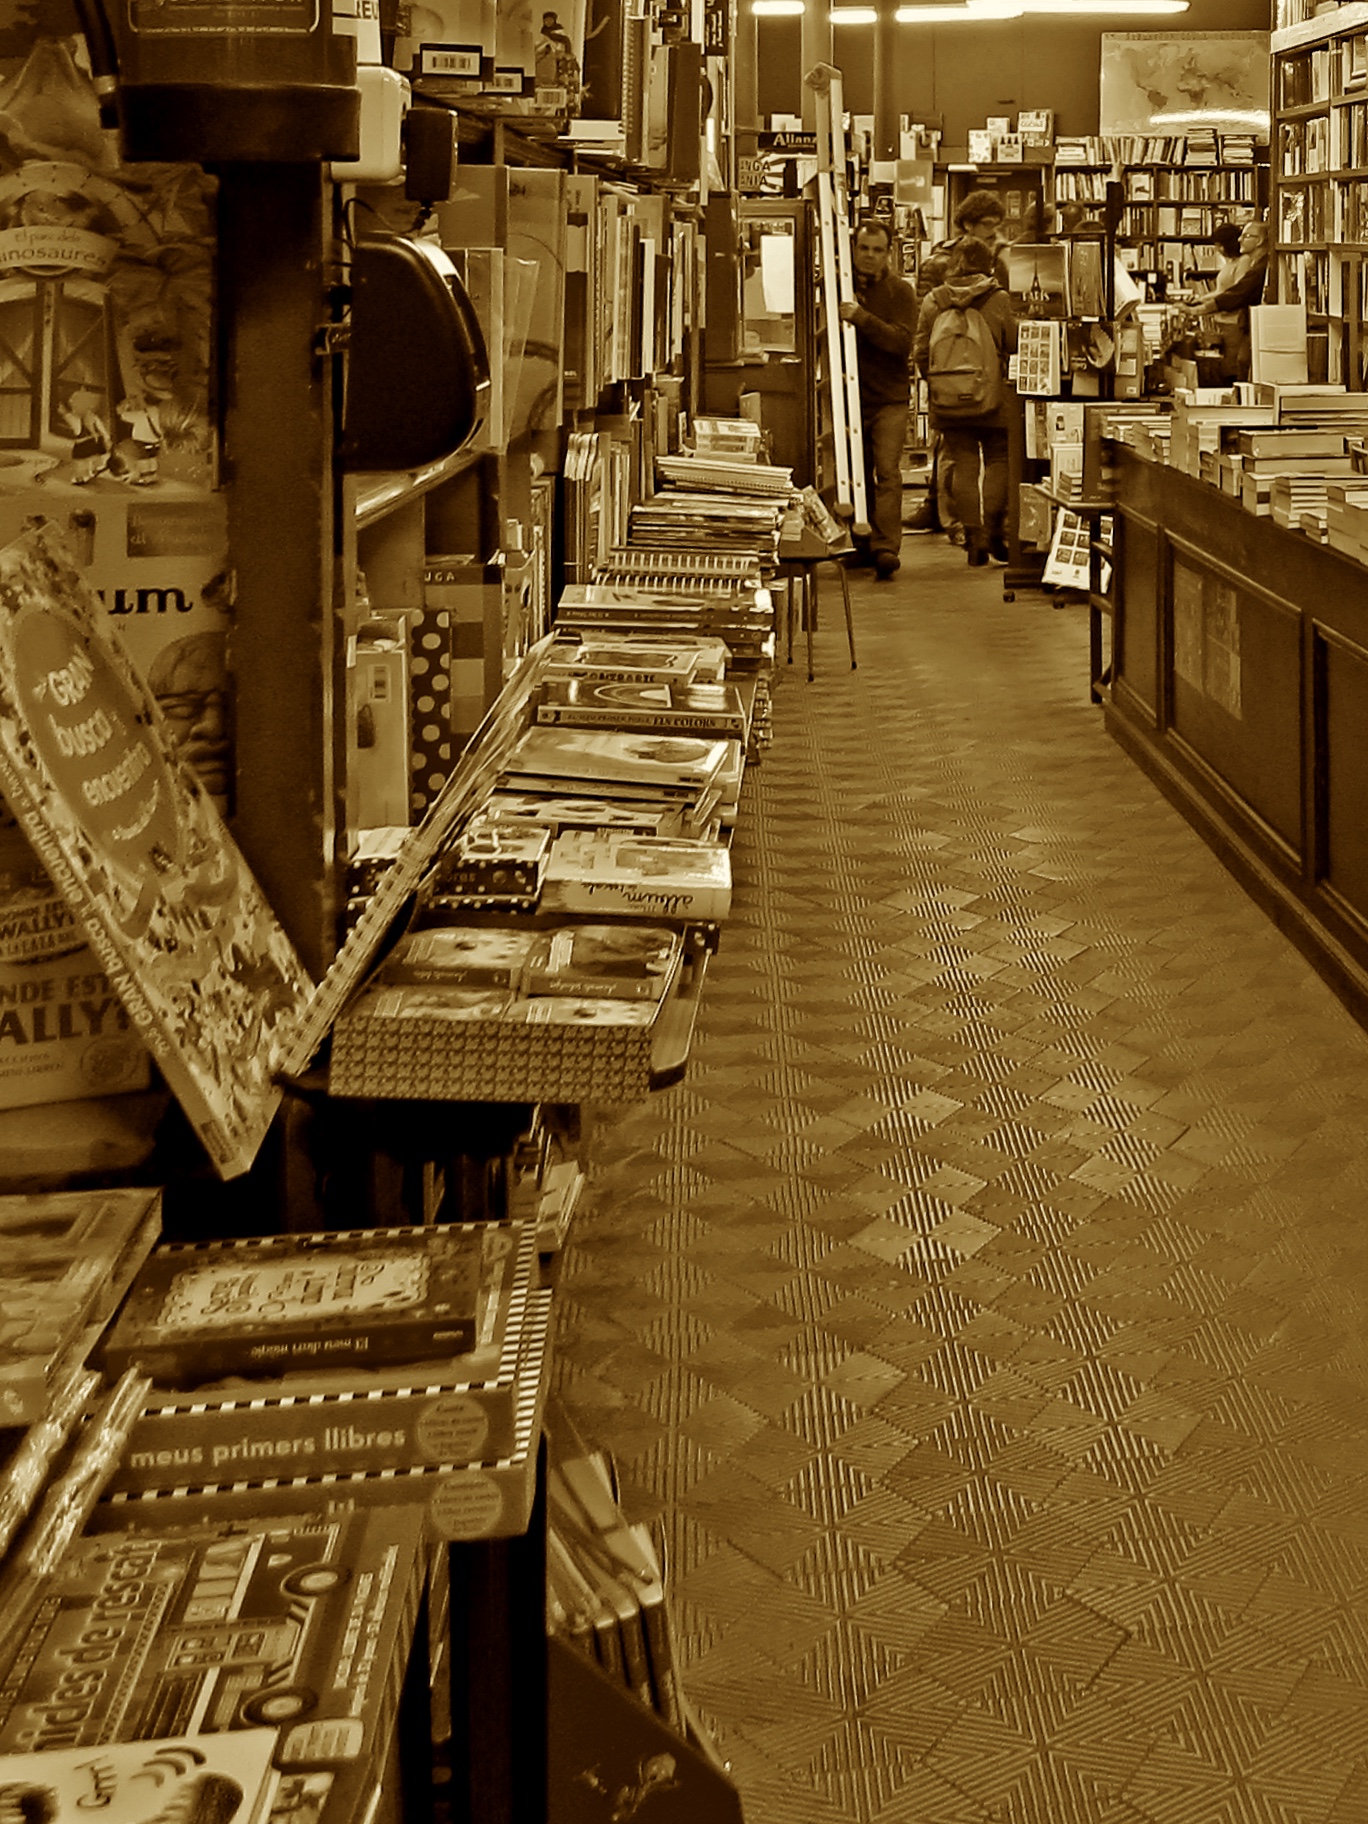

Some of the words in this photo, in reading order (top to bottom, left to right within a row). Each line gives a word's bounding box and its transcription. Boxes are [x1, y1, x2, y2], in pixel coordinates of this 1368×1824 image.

[113, 973, 153, 1026] GRAN
[130, 1442, 204, 1469] meus
[213, 1435, 317, 1467] primers
[323, 1424, 406, 1450] llibres
